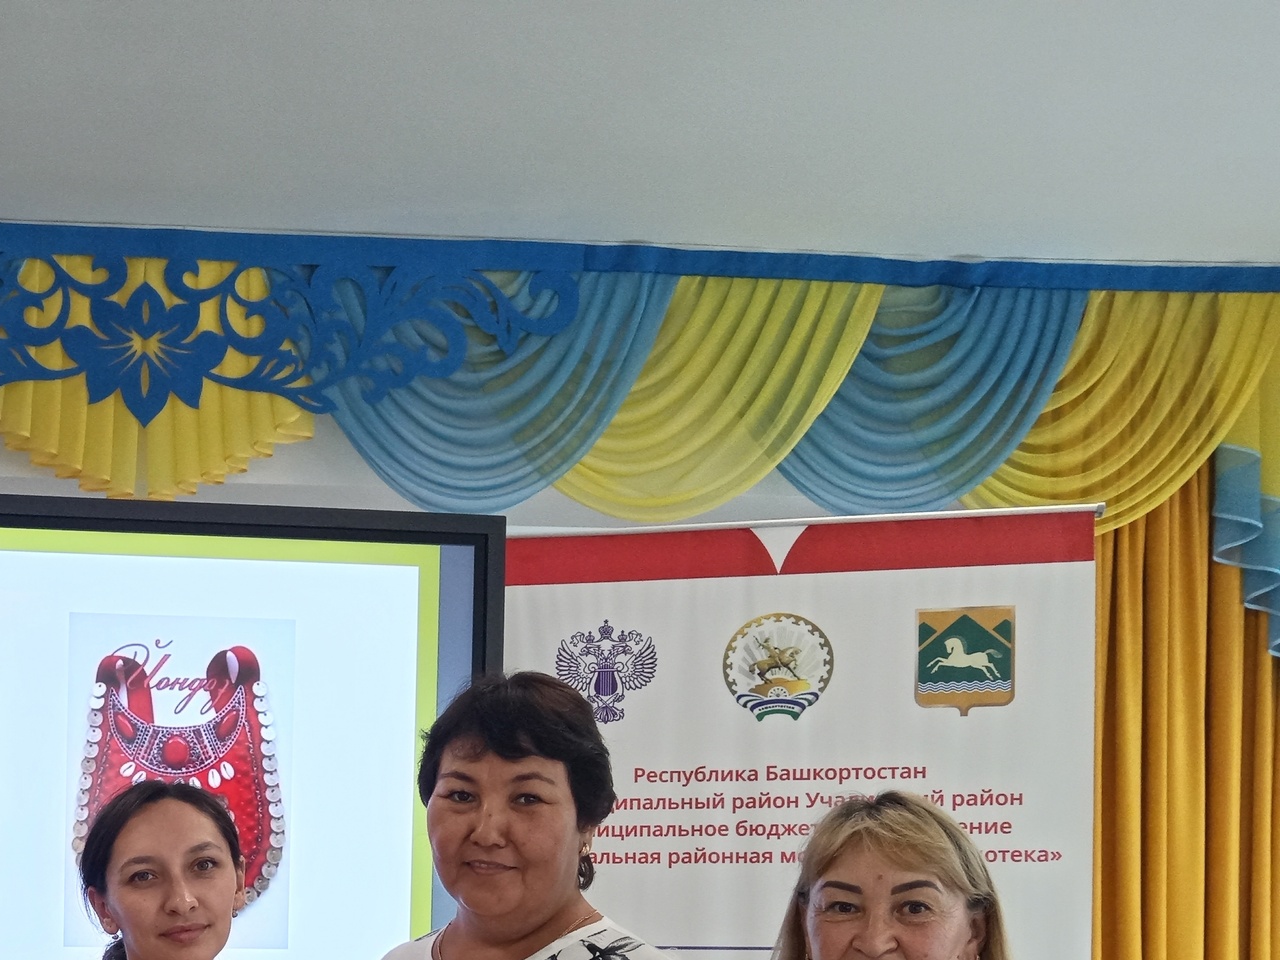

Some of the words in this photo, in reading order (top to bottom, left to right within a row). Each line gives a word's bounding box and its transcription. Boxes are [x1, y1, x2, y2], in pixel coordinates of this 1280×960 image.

[634, 766, 759, 787] Республика
[766, 765, 927, 784] Башкортостан
[611, 793, 725, 814] ипальный
[732, 791, 799, 813] район
[951, 788, 1024, 811] район
[593, 823, 729, 840] иципальное
[669, 847, 773, 868] районная
[982, 849, 1063, 863] отека»
